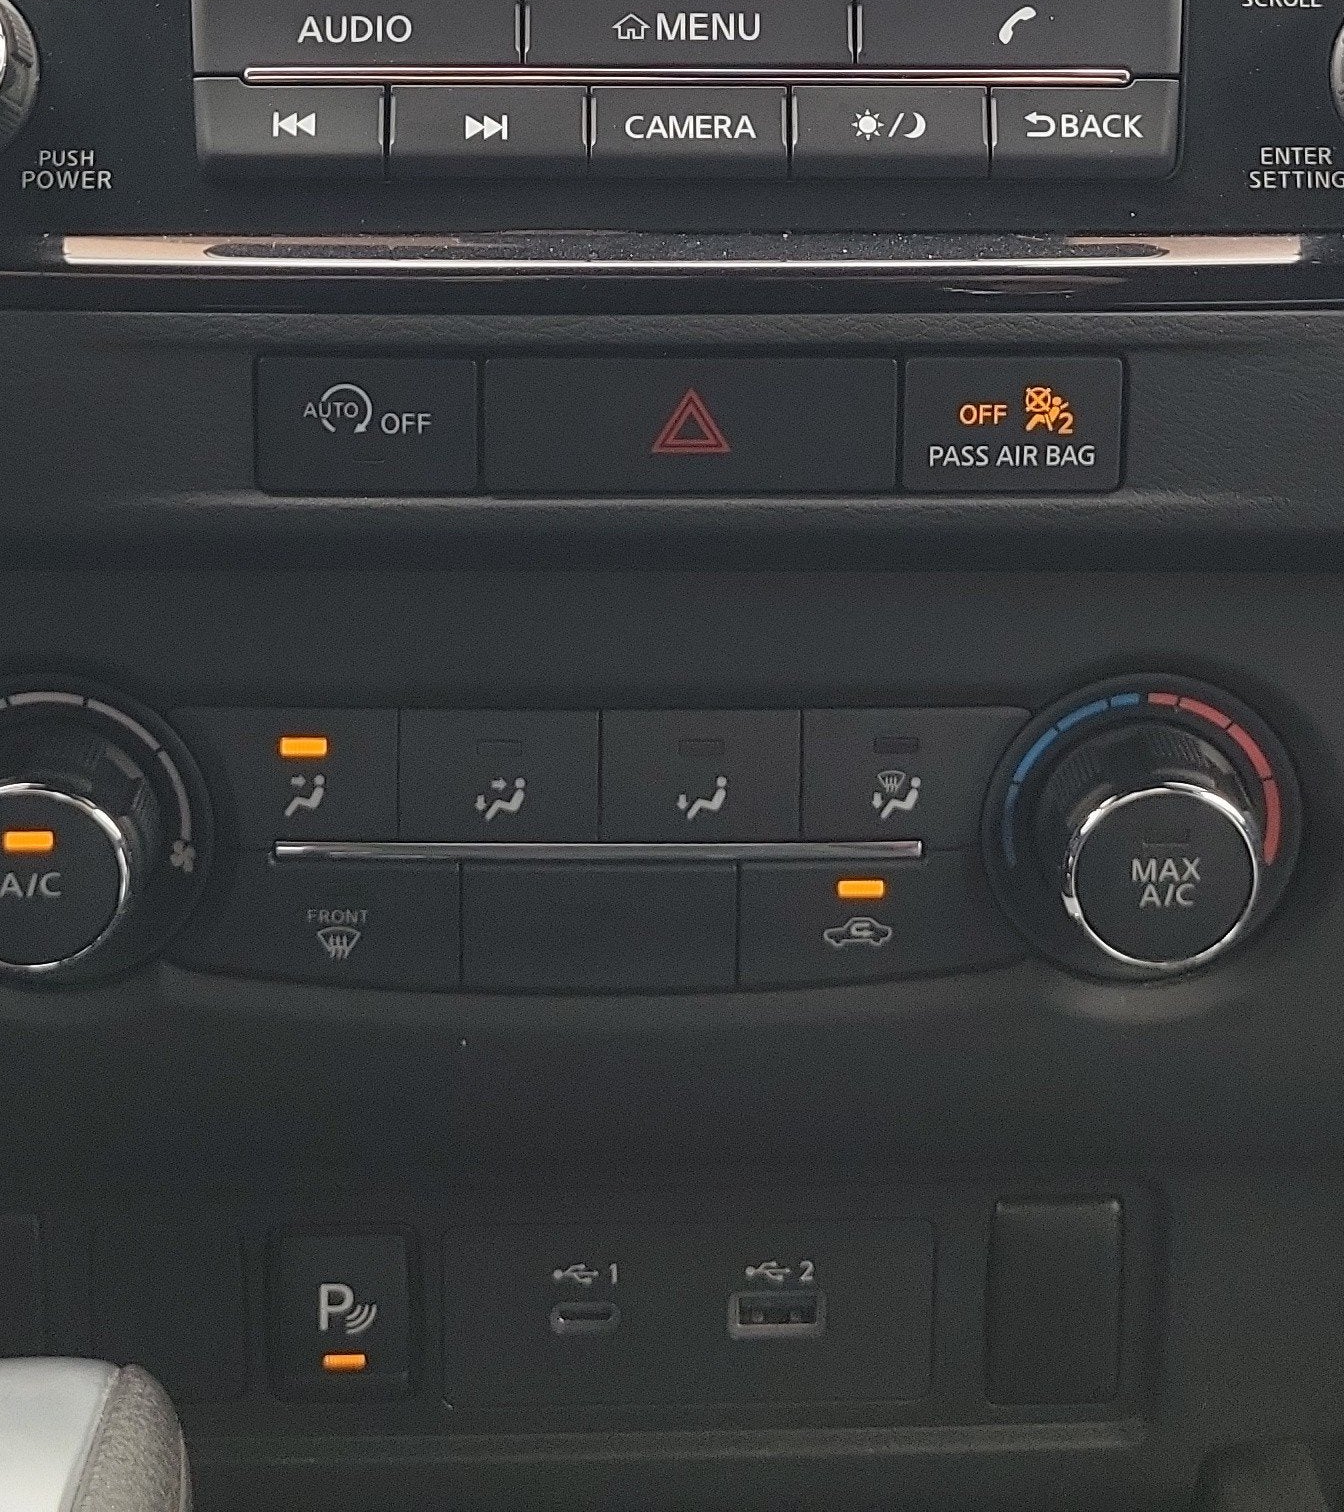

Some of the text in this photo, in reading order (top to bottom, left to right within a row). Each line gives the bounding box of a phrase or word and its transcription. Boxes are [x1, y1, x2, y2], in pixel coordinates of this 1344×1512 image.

[297, 14, 413, 43] AUDIO
[656, 13, 761, 41] MENU
[624, 115, 757, 139] CAMERA
[1061, 114, 1143, 139] BACK
[39, 149, 95, 167] PUSH
[1261, 147, 1333, 165] ENTER
[21, 170, 113, 189] POWER
[303, 401, 432, 434] AUTO OFF
[959, 404, 1007, 425] OFF
[929, 444, 1096, 467] PASS AIR BAG
[1131, 857, 1202, 882] MAX
[1139, 883, 1196, 908] A/C
[307, 909, 368, 924] FRONT
[798, 1260, 815, 1282] 2
